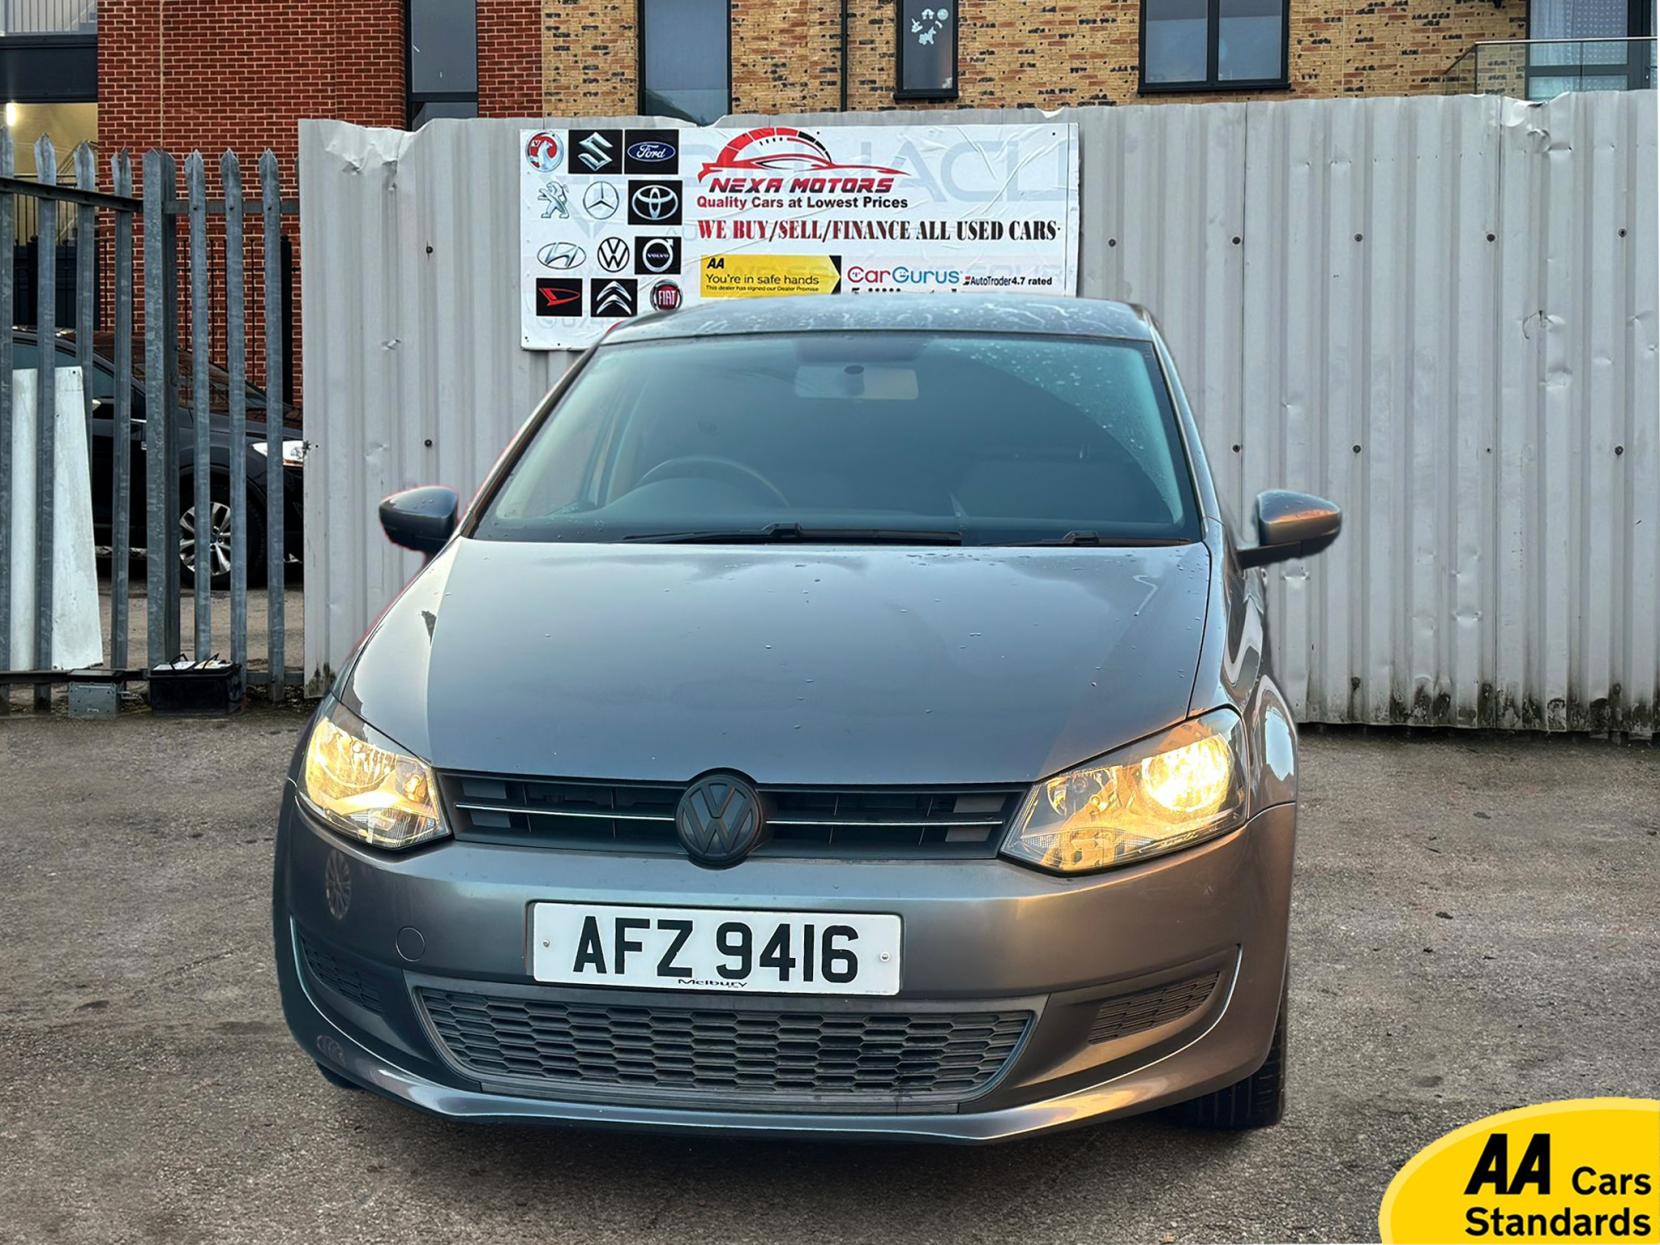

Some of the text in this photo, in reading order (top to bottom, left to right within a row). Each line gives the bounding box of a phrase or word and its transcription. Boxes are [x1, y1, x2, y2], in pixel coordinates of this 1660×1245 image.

[636, 143, 665, 159] Ford
[709, 178, 894, 193] NEXA MOTORS
[697, 196, 908, 210] Quality Cars at Lowest Prices
[697, 220, 726, 239] WE
[916, 220, 950, 240] ALL
[956, 220, 1004, 240] USED
[1008, 220, 1057, 240] CARS
[706, 257, 725, 269] AA
[706, 274, 819, 285] You're in safe hands
[847, 266, 960, 283] CarGurus
[1028, 277, 1052, 285] rated
[658, 290, 676, 305] FIAT
[572, 916, 859, 983] AFZ 9416
[678, 979, 748, 988] Melbury
